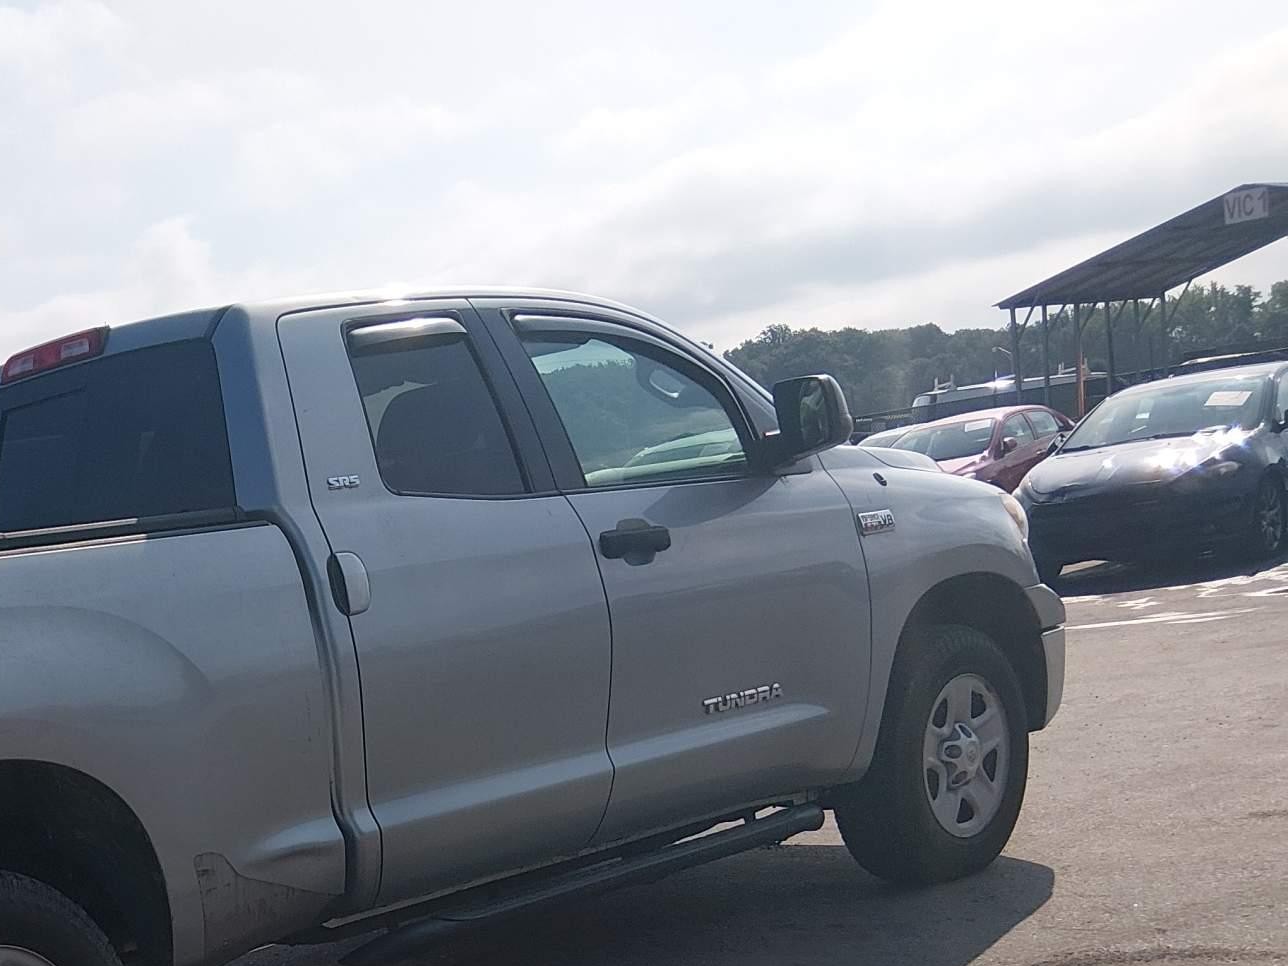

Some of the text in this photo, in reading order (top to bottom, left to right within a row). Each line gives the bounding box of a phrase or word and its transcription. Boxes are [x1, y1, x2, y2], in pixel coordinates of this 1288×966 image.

[1225, 189, 1267, 219] VIC 1
[878, 513, 894, 526] V8
[702, 682, 783, 714] TUNDRA
